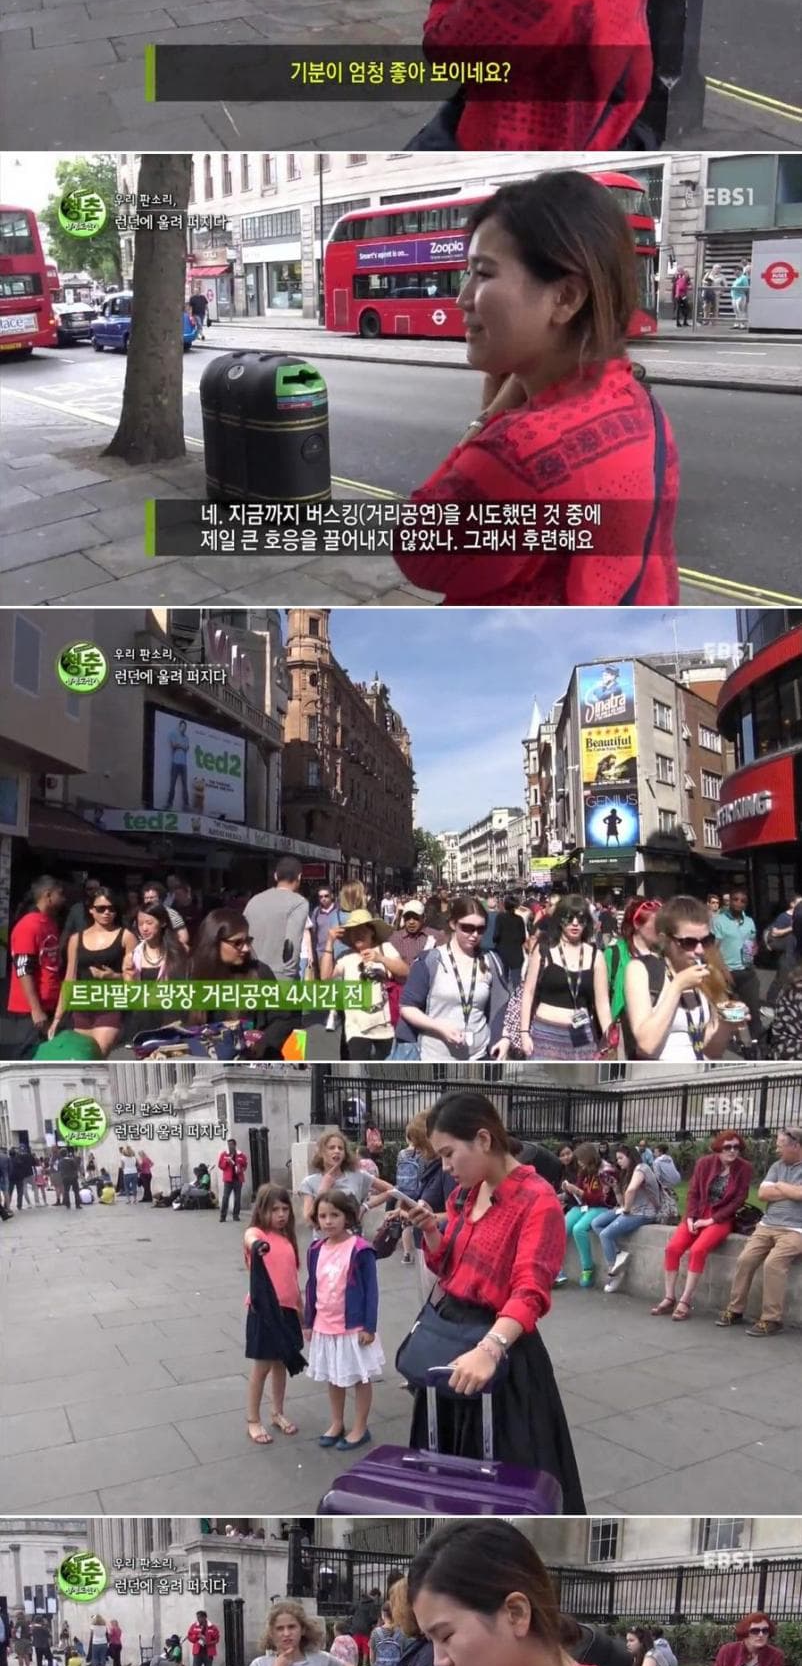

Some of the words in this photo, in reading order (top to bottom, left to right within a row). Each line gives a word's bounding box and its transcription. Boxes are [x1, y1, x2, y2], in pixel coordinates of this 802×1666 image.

[430, 241, 464, 254] Zoopla
[585, 735, 632, 749] Beautiful
[194, 745, 242, 777] ted2
[585, 794, 639, 808] GENIUS
[123, 811, 178, 830] ted2
